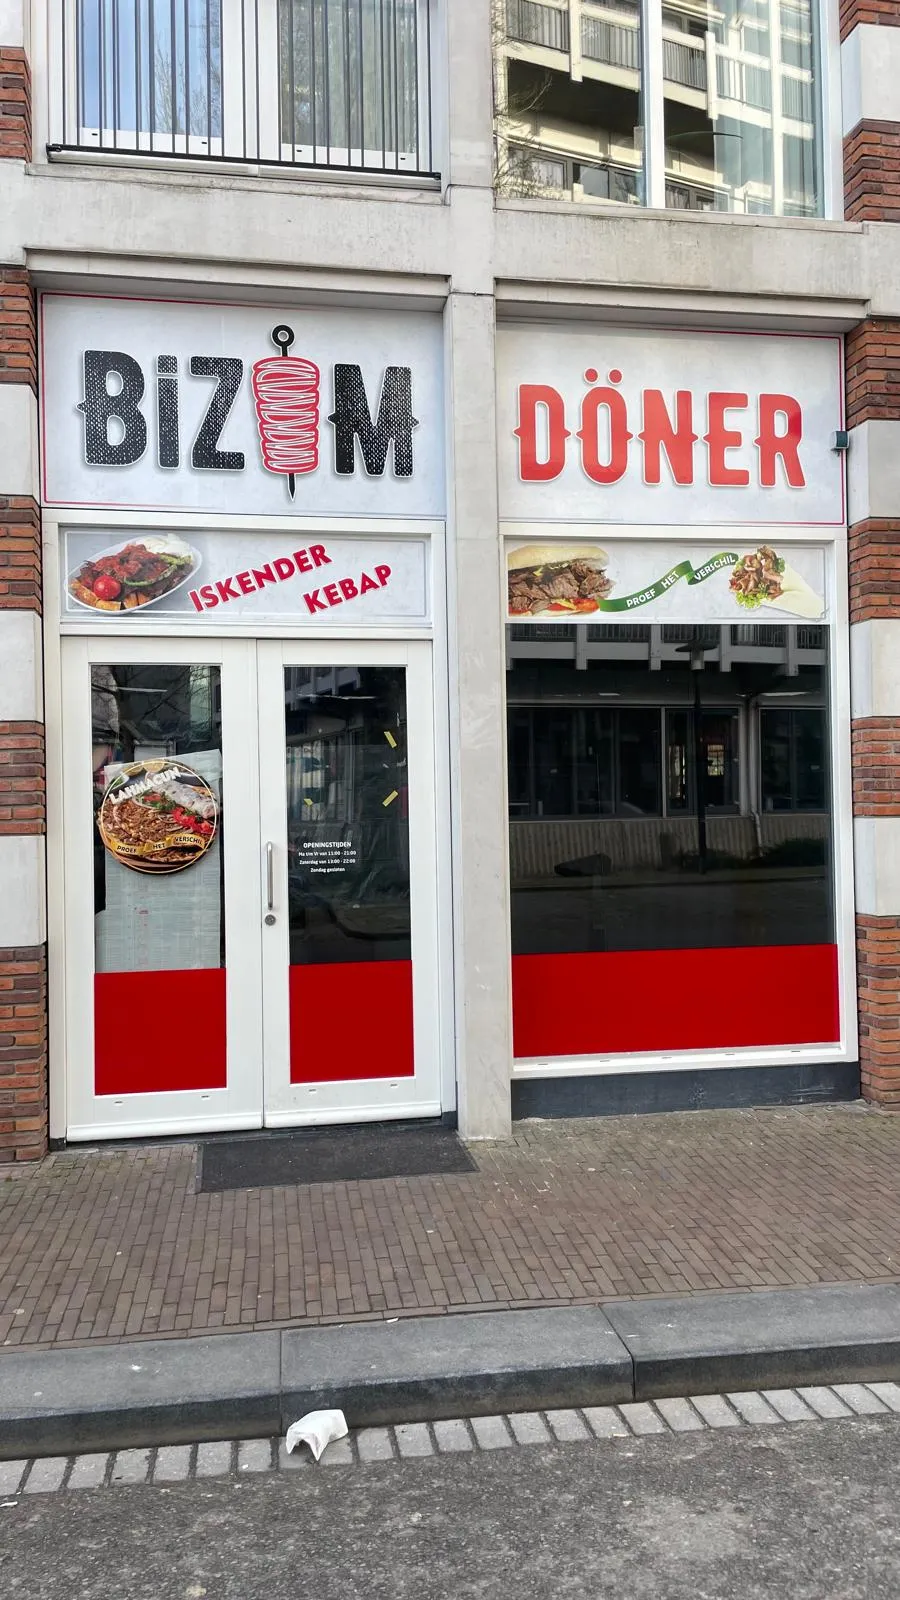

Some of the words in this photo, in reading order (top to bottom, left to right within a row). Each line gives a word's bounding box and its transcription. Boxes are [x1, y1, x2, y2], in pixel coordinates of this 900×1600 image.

[513, 368, 807, 488] DÖNER
[188, 543, 332, 613] ISKENDER
[302, 564, 392, 615] KEBAP
[626, 588, 656, 608] PROEF
[660, 570, 680, 589] HET
[694, 554, 736, 581] VERSCHIL
[108, 766, 181, 805] LAHMACUN
